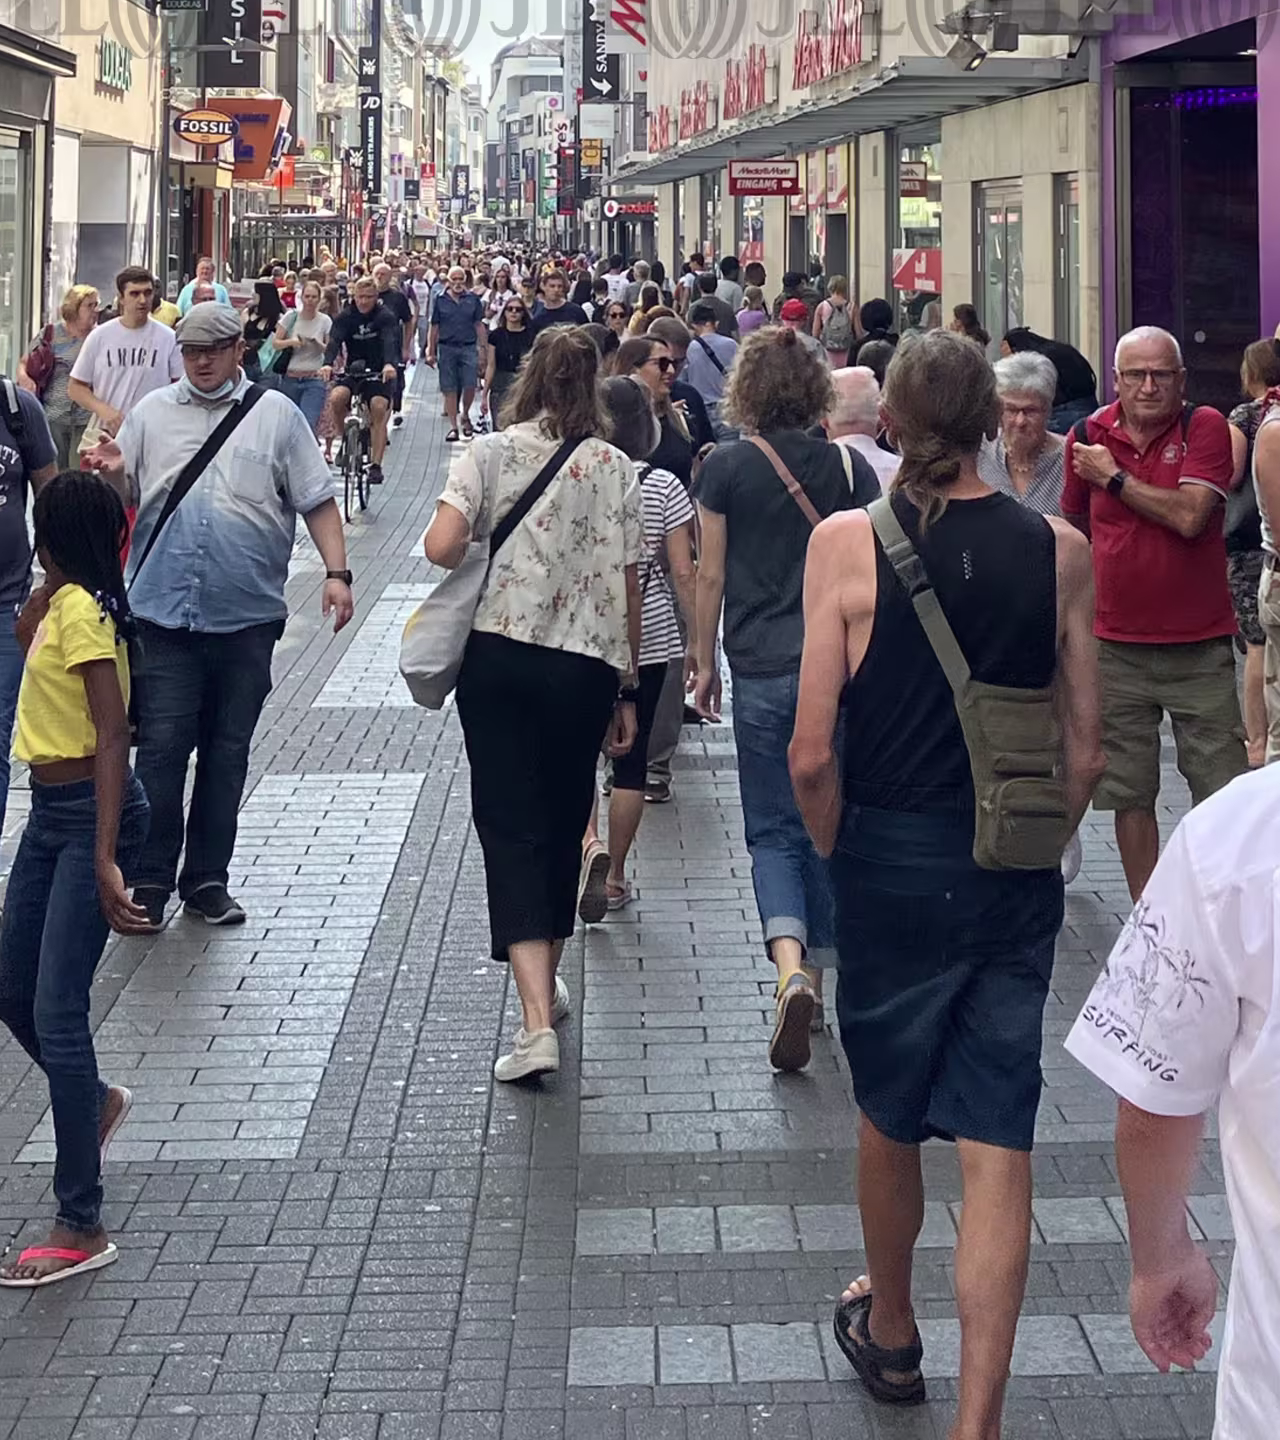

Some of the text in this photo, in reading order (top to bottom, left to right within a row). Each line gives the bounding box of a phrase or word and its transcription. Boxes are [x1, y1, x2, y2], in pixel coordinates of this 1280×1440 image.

[179, 119, 233, 136] FOSSIL
[736, 178, 778, 191] EINGANG
[1082, 1005, 1179, 1082] SURFING
